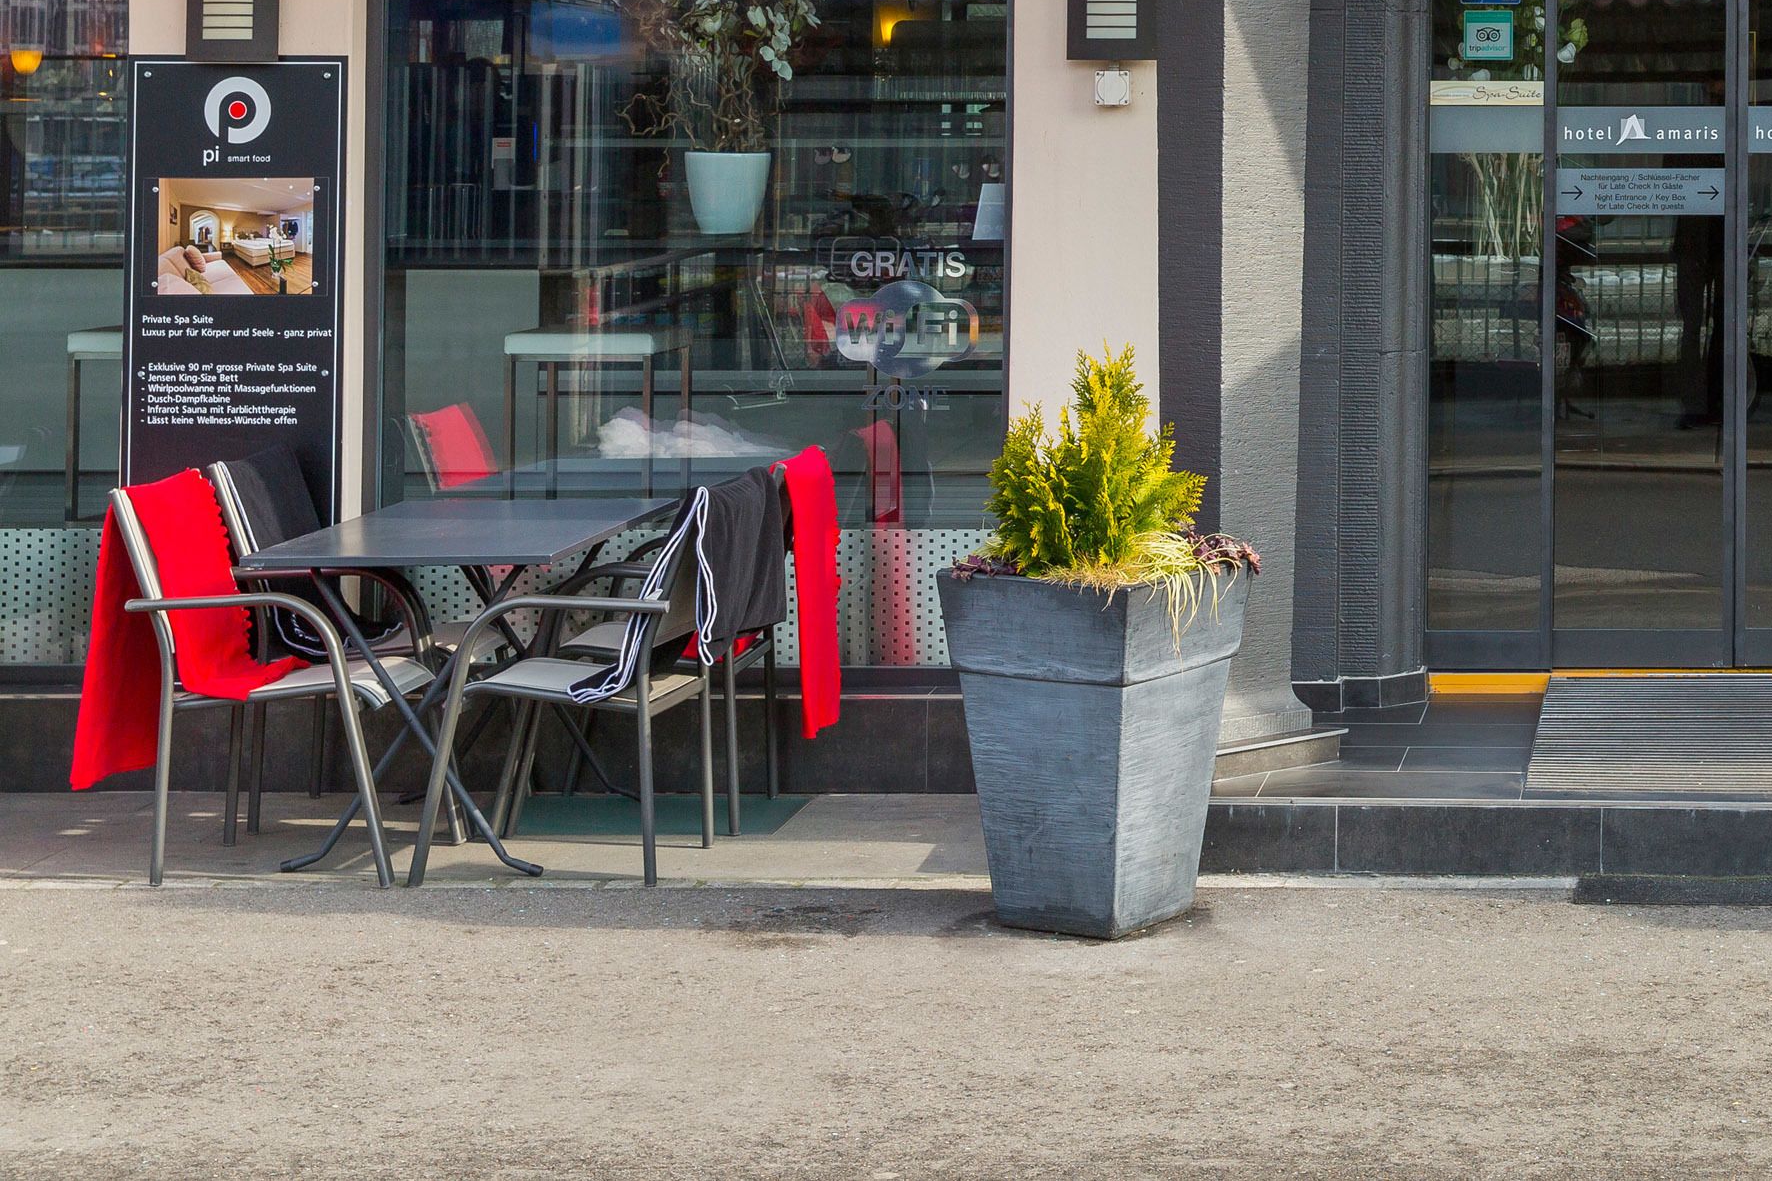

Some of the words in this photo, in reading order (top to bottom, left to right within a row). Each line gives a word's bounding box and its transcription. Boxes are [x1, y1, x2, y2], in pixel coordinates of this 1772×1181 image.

[1469, 45, 1506, 53] tripadvisor
[1564, 126, 1611, 140] hotel
[1657, 126, 1718, 140] amaris
[203, 145, 219, 166] pi
[1581, 174, 1629, 182] Nachteingang
[1595, 194, 1612, 202] Night
[1656, 194, 1669, 202] Key
[851, 251, 965, 278] GRATIS
[142, 315, 171, 324] Private
[174, 315, 190, 325] Spa
[193, 315, 214, 324] Suite
[142, 328, 165, 337] Luxus
[169, 330, 183, 338] pur
[186, 328, 198, 337] für
[201, 328, 230, 338] Körper
[233, 328, 249, 337] und
[252, 328, 274, 337] Seele
[284, 330, 304, 338] ganz
[307, 329, 332, 338] privat
[148, 363, 185, 371] Exklusive
[188, 363, 199, 371] 90
[216, 365, 243, 373] grosse
[246, 363, 275, 371] Private
[278, 363, 293, 373] Spa
[296, 363, 317, 371] Suite
[148, 374, 176, 382] Jensen
[179, 374, 216, 383] King-Size
[220, 374, 238, 382] Bett
[148, 384, 214, 394] Whirlpoolwanne
[218, 385, 231, 393] mit
[235, 384, 316, 394] Massagefunktionen
[147, 395, 230, 404] Dusch-Dampfkabine
[862, 385, 950, 411] ZONE
[147, 405, 179, 414] Infrarot
[182, 406, 207, 414] Sauna
[210, 406, 224, 414] mit
[227, 405, 296, 415] Farblichttherapie
[147, 416, 168, 424] Lässt
[171, 416, 194, 424] keine
[197, 416, 271, 424] Wellness-Wünsche
[274, 416, 297, 424] offen
